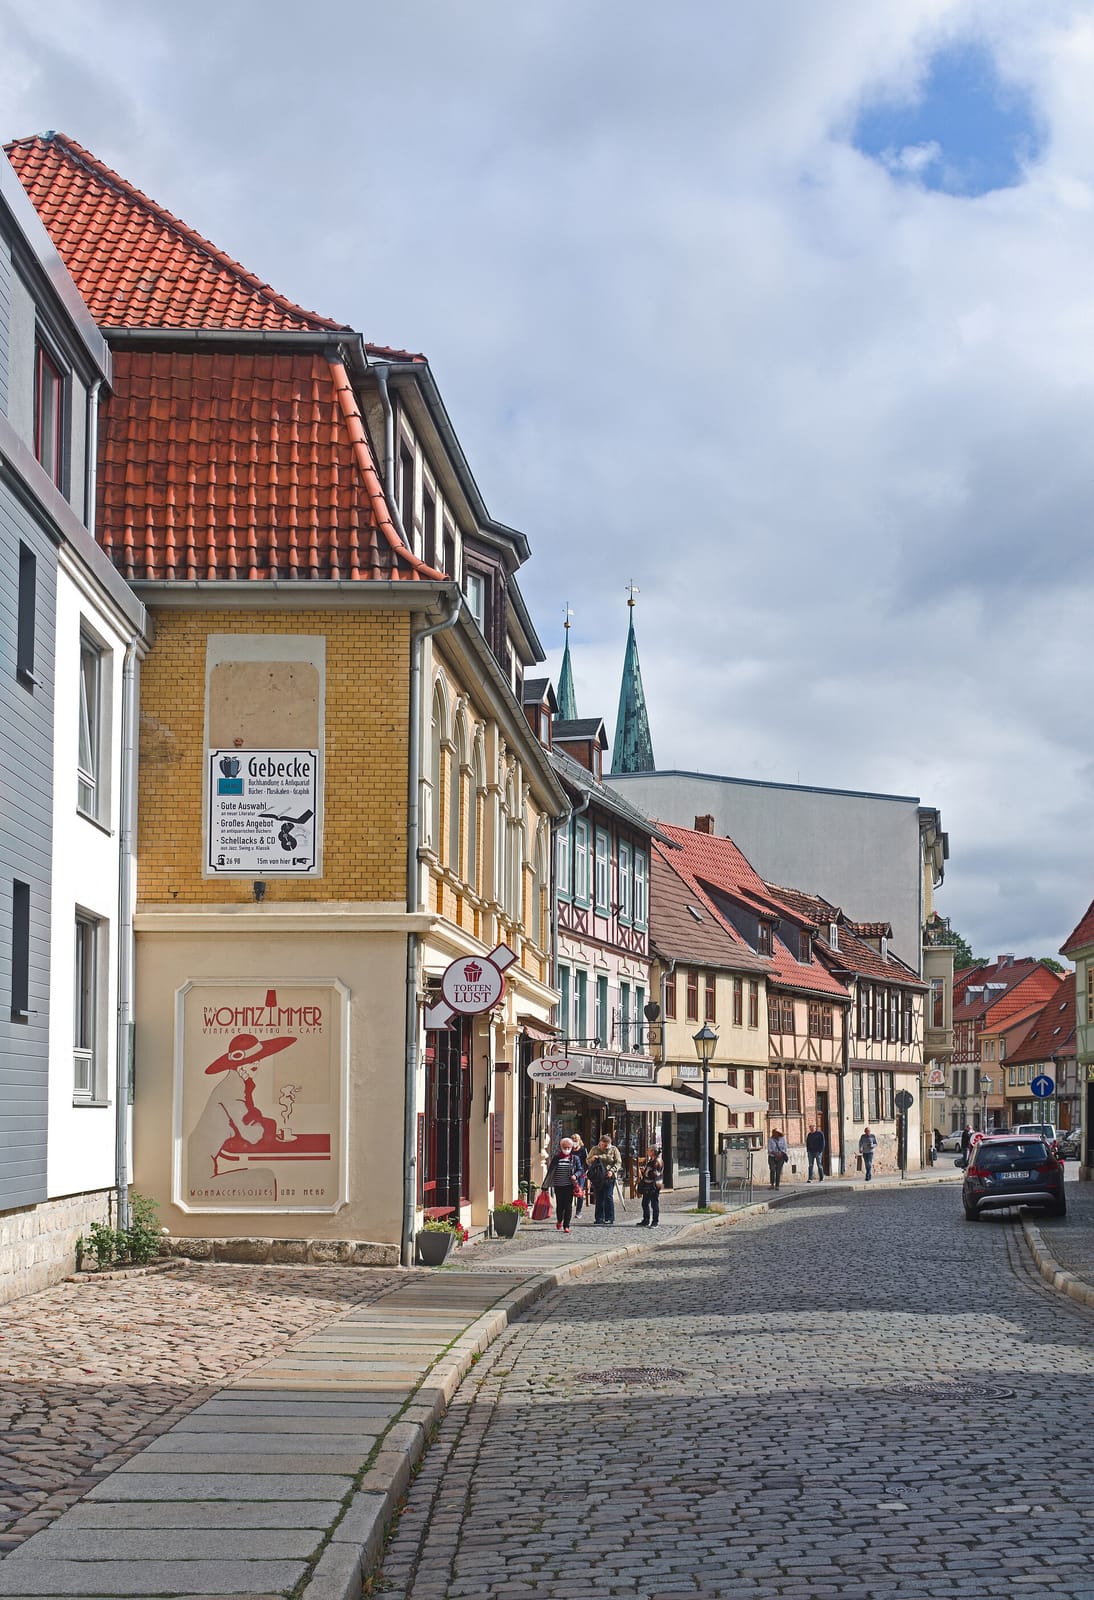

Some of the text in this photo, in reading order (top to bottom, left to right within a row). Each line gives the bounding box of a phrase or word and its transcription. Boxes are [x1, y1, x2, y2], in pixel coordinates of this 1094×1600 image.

[248, 756, 310, 778] Gebecke
[248, 778, 280, 787] Buchhandlung
[284, 778, 310, 787] Antiquariat
[248, 787, 310, 796] Bücher Musikalien Graphik
[220, 801, 267, 810] Gute Auswahl
[220, 819, 274, 830] Großes Angebot
[220, 836, 276, 845] Schellacks & CD
[226, 857, 234, 865] 26
[257, 857, 269, 865] 15m
[280, 857, 291, 865] hier
[453, 983, 492, 992] TORTEN
[454, 991, 492, 1003] LUST
[203, 1006, 218, 1014] DAS
[203, 997, 323, 1027] WOHNZIMMER
